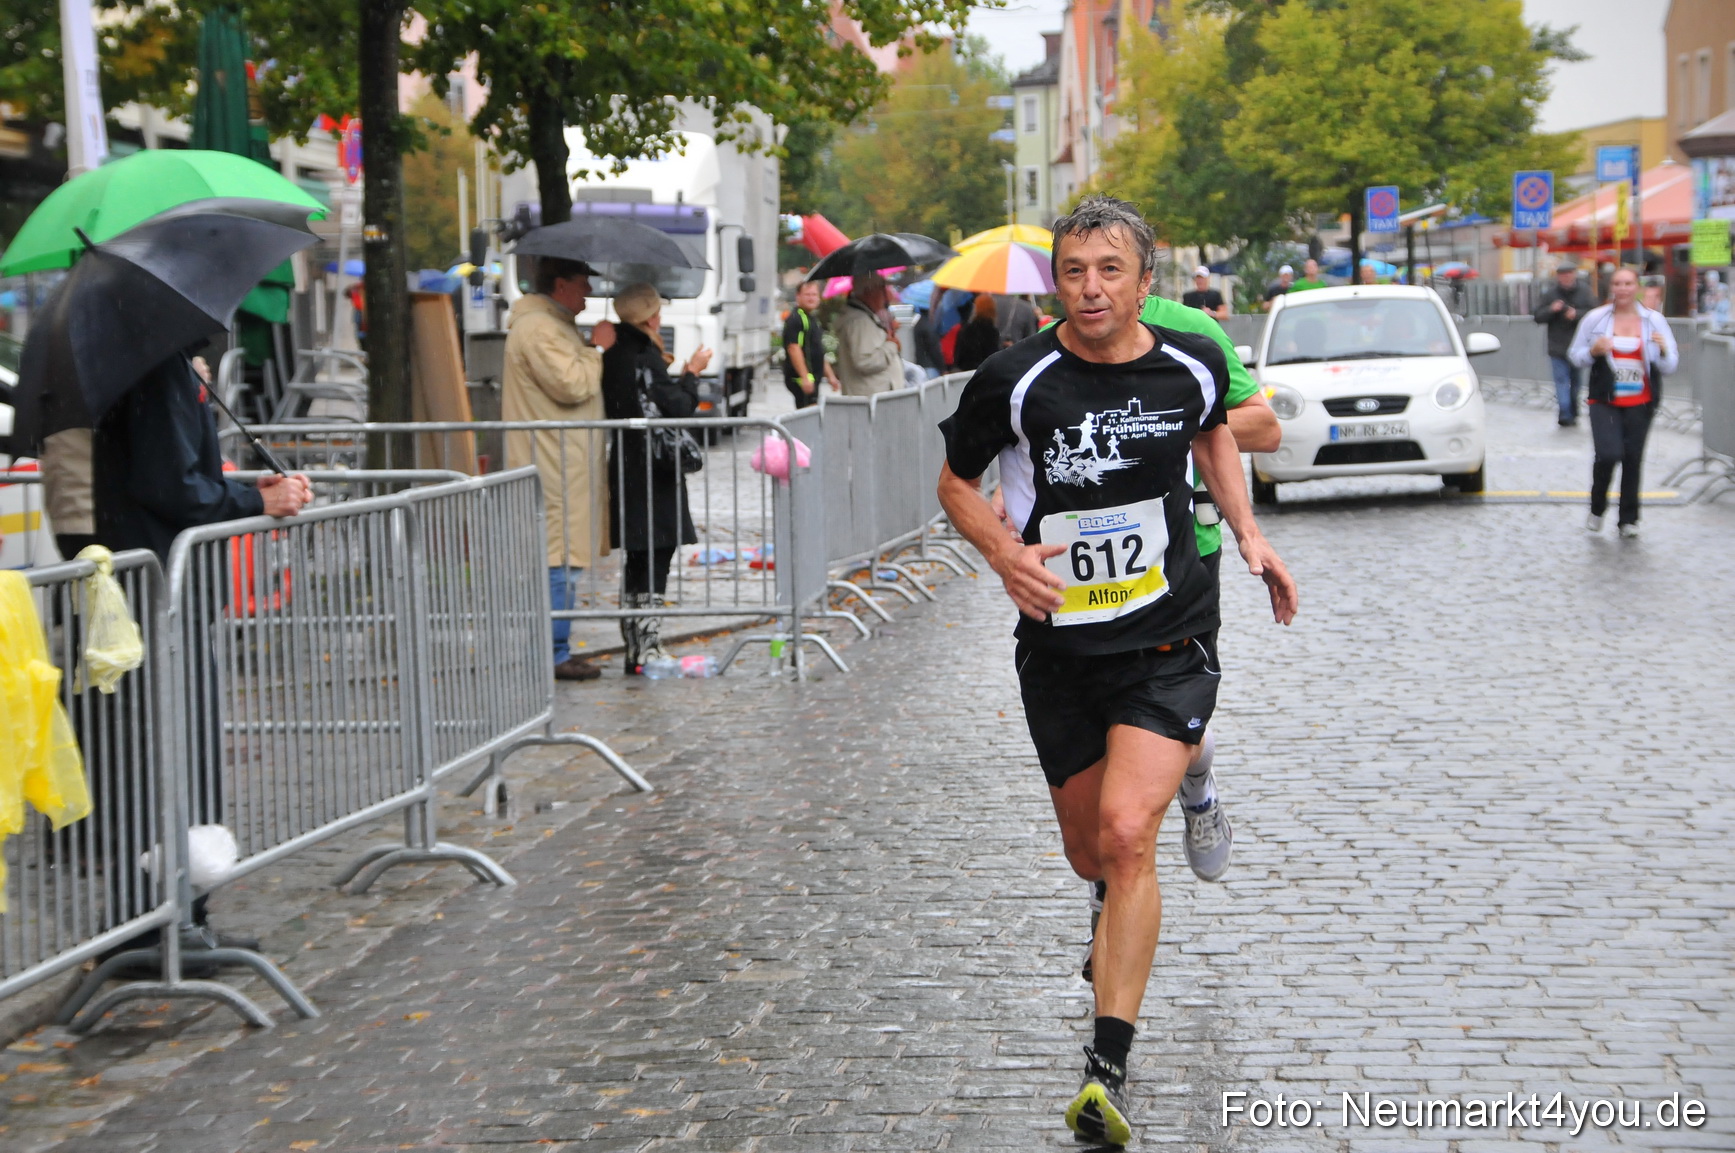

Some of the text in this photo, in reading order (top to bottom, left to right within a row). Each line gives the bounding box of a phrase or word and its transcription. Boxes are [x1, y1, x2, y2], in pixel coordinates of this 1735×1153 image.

[1372, 218, 1397, 230] TAXI
[1517, 211, 1549, 226] TAXI
[1359, 401, 1377, 409] KIA
[1102, 421, 1183, 435] Frühlingslauf
[1107, 417, 1118, 425] 11.
[1131, 432, 1147, 440] April
[1339, 423, 1406, 437] NM RK 264
[1078, 512, 1127, 529] BOCK
[1070, 533, 1147, 582] 612
